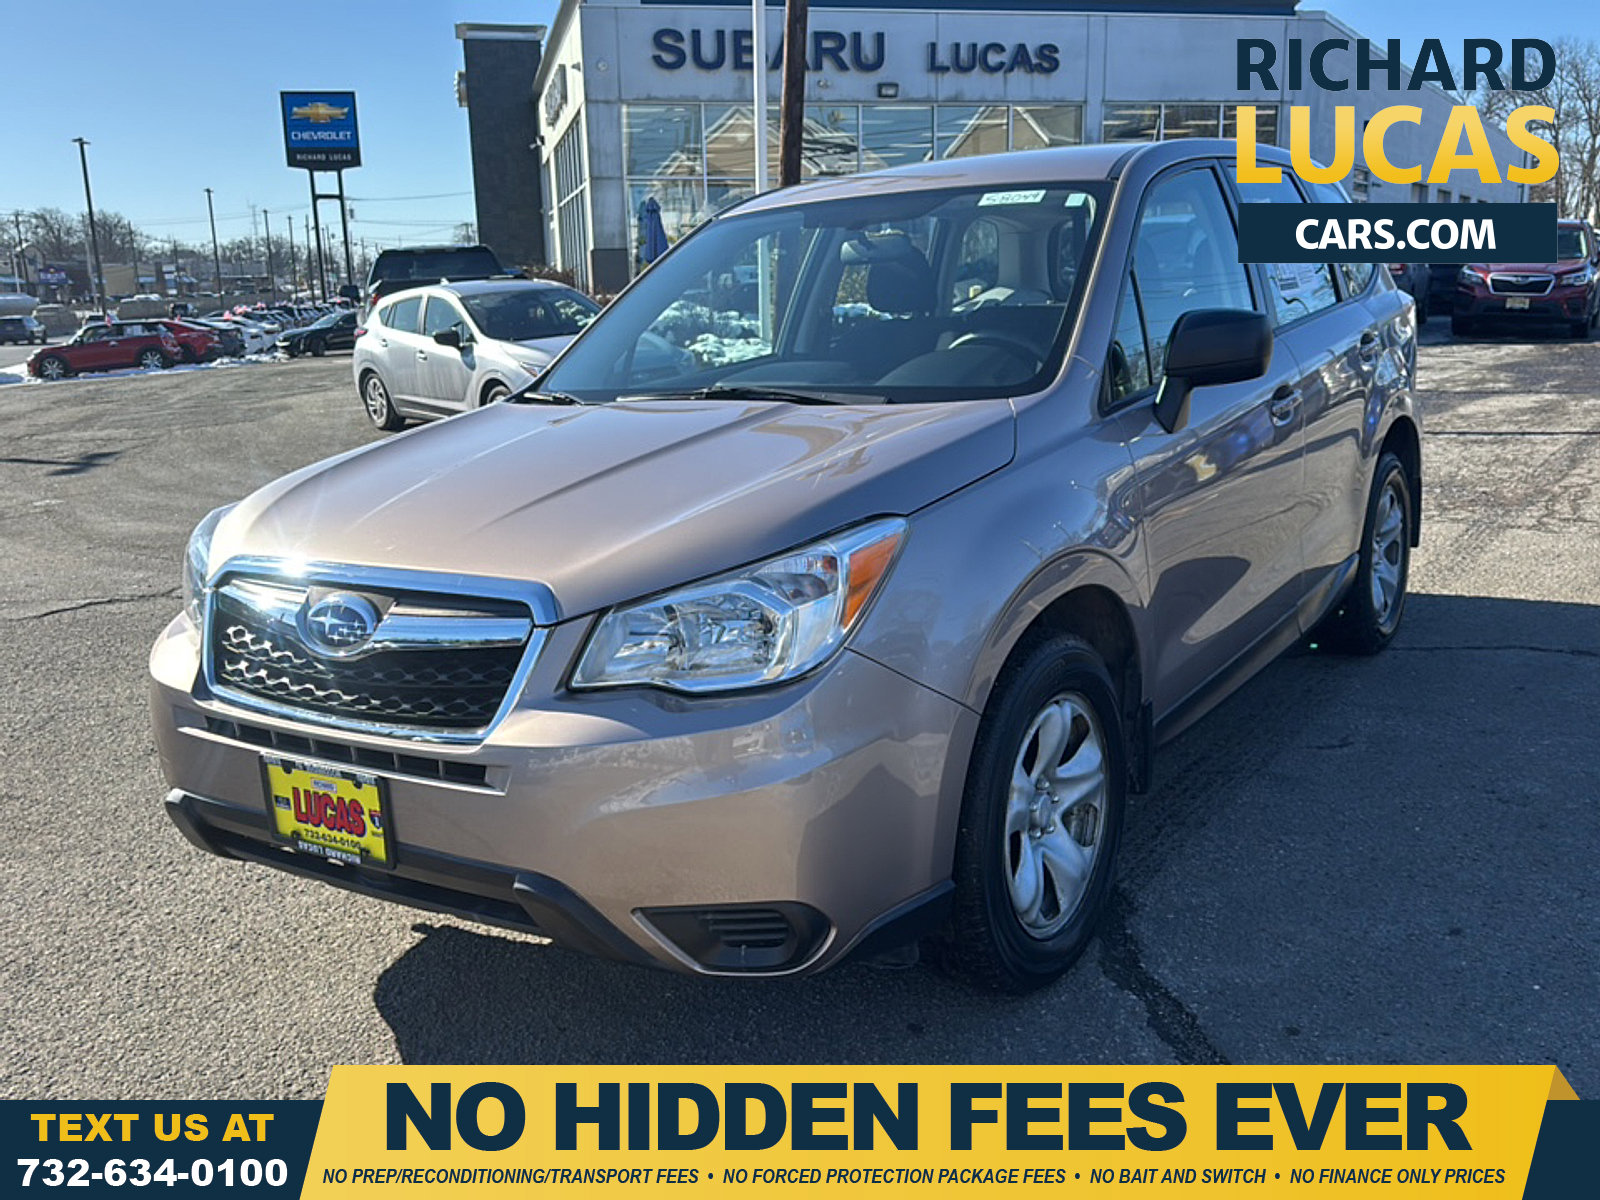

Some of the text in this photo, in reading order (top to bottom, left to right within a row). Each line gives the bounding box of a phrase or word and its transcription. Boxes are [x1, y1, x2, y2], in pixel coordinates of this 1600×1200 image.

[927, 42, 1060, 73] LUCAS
[291, 131, 352, 141] CHEVROLET
[296, 153, 352, 161] RICHARD LUCAS
[292, 787, 366, 837] LUCAS
